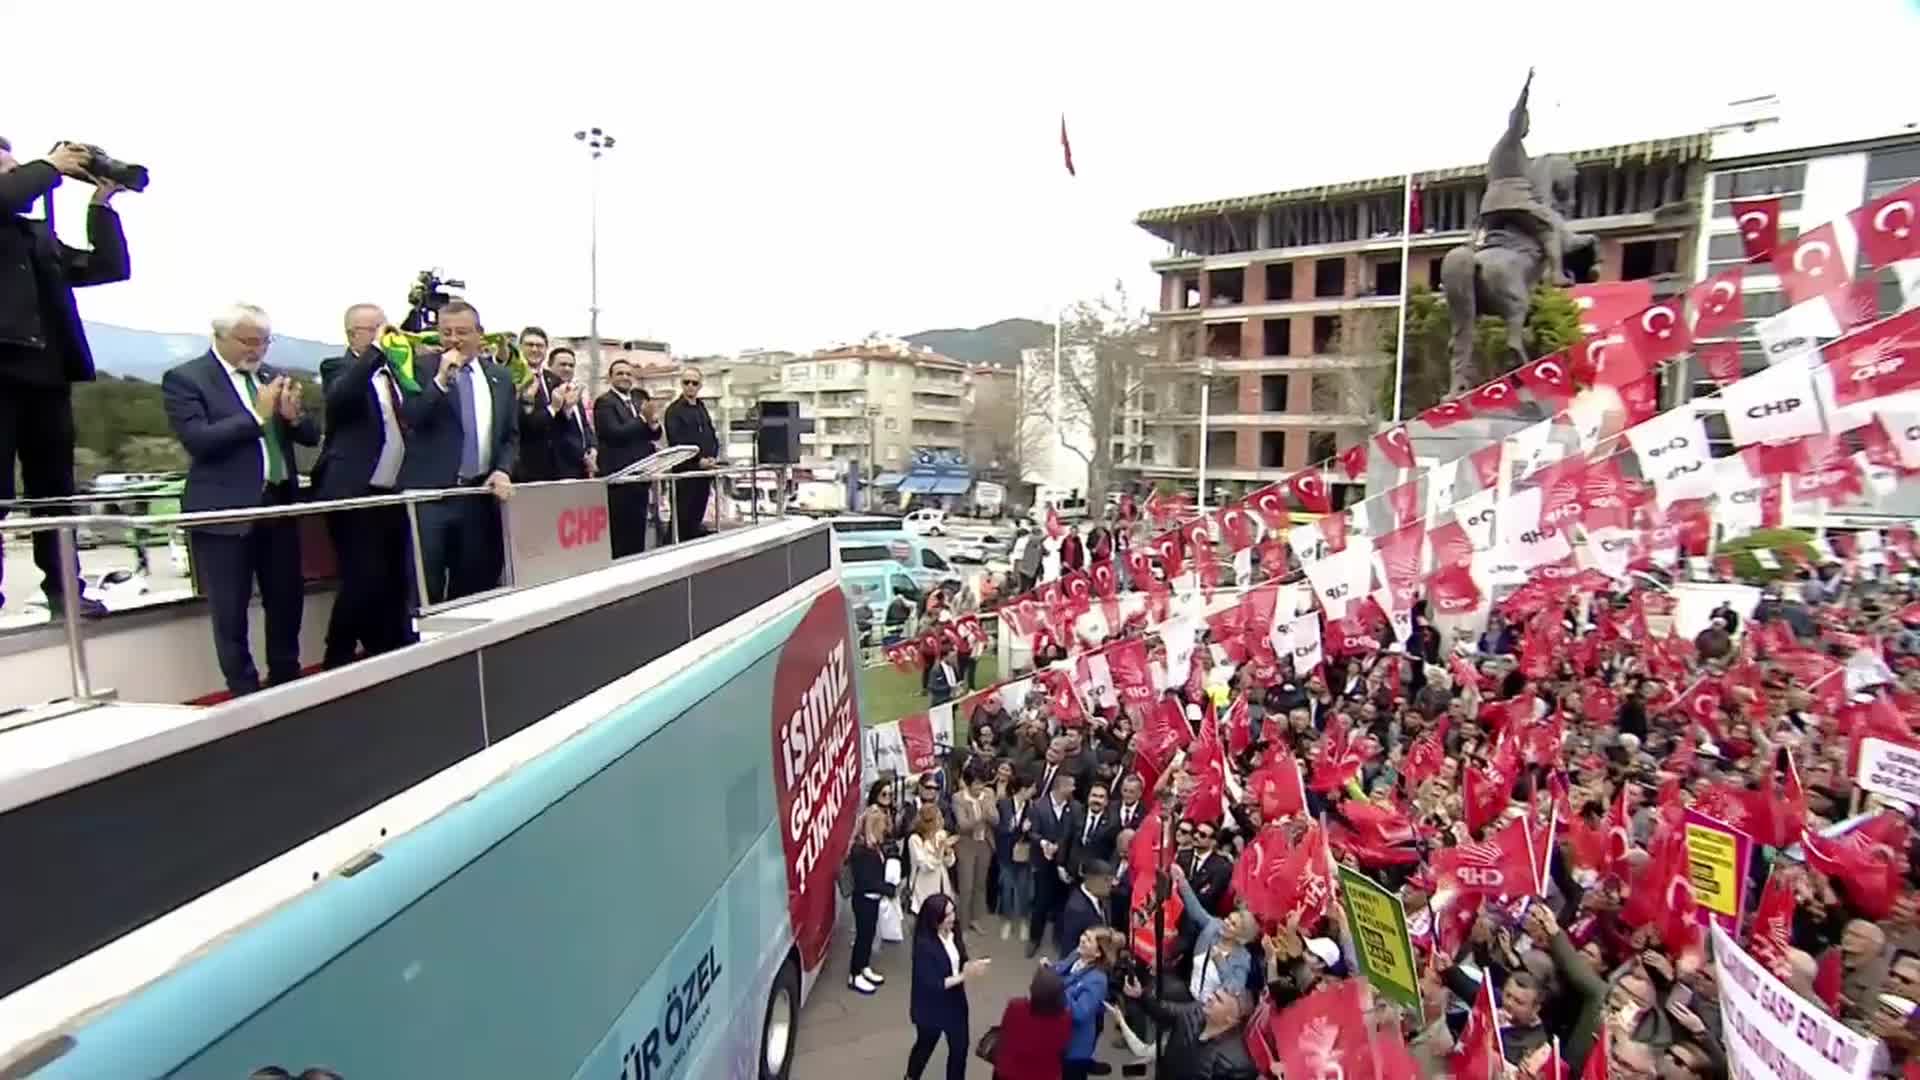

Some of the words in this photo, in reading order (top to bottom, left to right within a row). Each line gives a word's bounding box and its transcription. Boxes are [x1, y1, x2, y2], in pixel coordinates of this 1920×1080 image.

[1747, 398, 1802, 418] CHP
[557, 505, 608, 549] CHP
[665, 944, 722, 1046] ÖZEL
